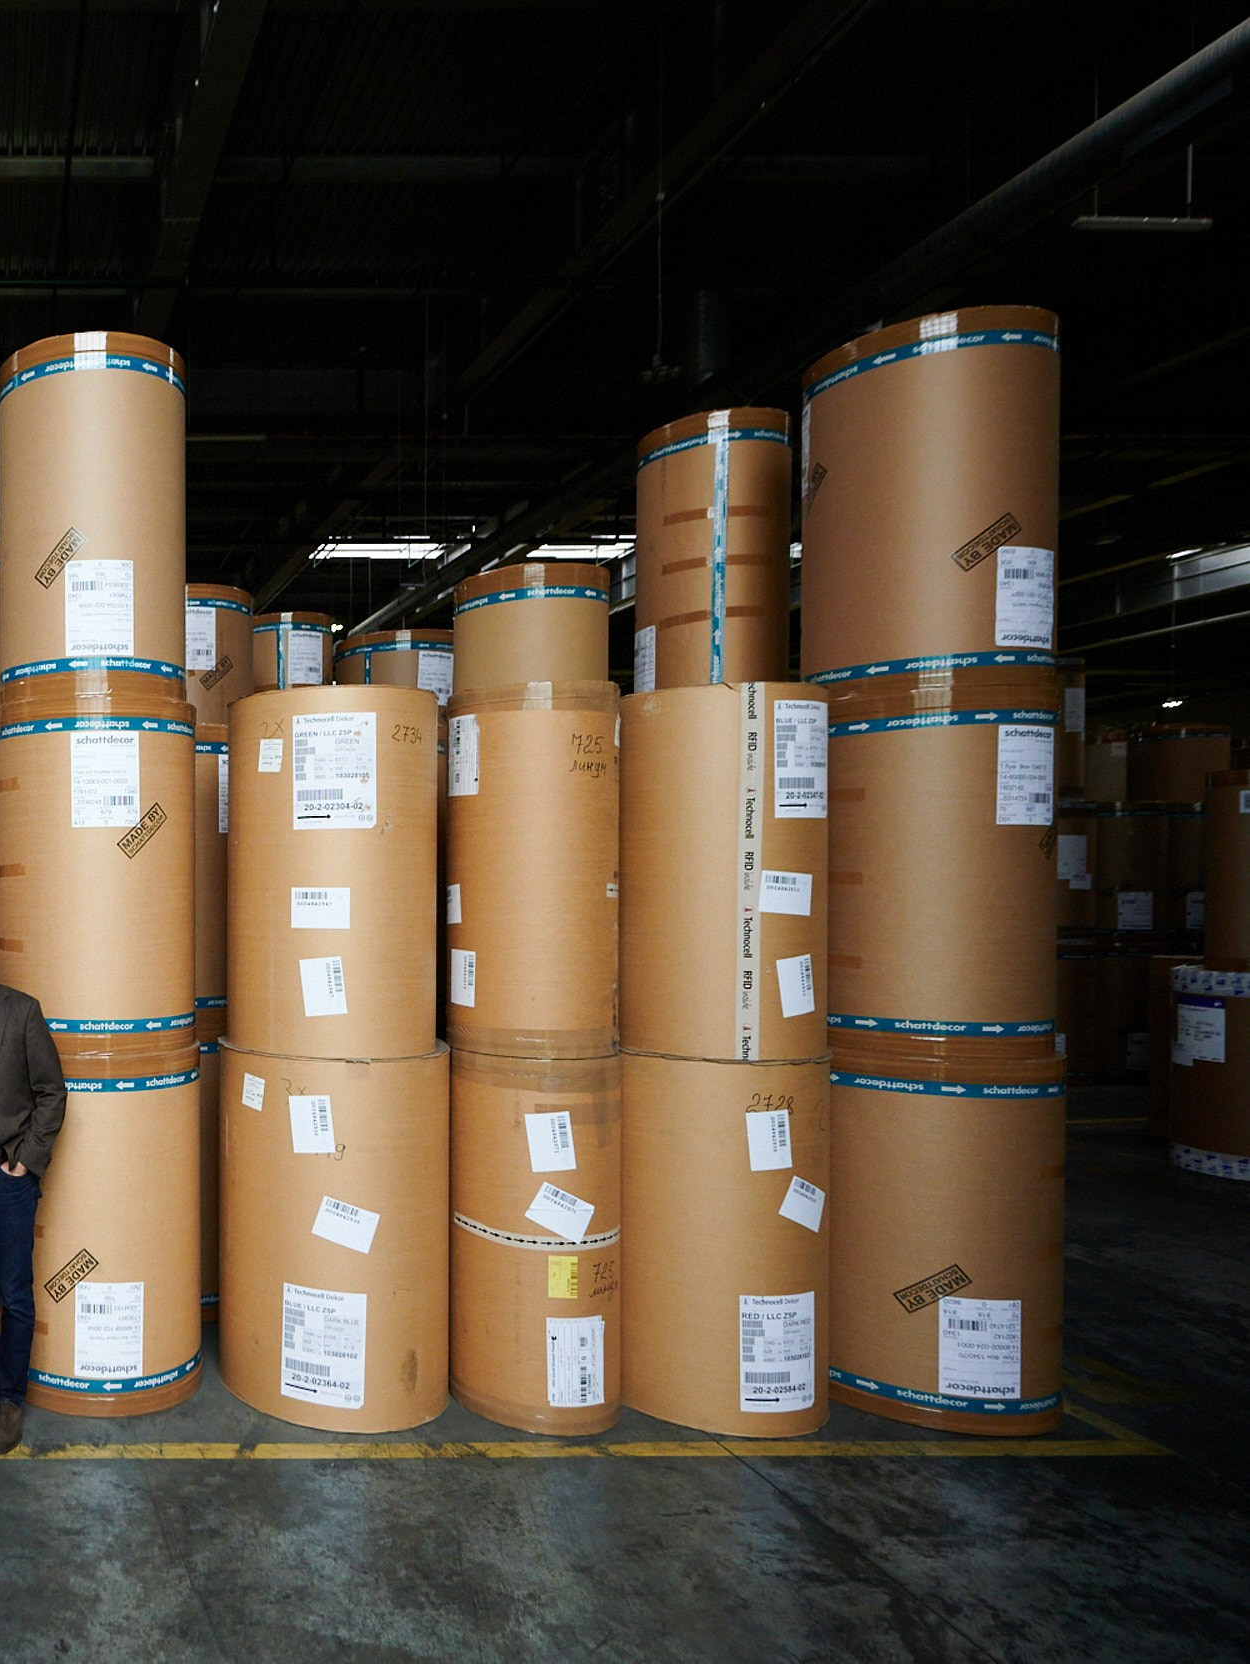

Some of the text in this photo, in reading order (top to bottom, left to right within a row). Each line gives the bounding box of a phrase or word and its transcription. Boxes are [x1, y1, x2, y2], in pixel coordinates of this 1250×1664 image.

[964, 523, 1018, 567] MADE BY
[42, 533, 83, 585] MADE BY
[527, 588, 576, 597] schattdecor
[72, 643, 129, 652] schattdecor
[15, 662, 57, 676] schattdecor
[100, 659, 152, 669] schattdecor
[905, 656, 978, 670] schattdecor
[748, 682, 758, 720] echnocell
[886, 715, 959, 727] schattdecor
[1012, 711, 1054, 720] schattdecor
[1, 724, 35, 736] schattdecor
[75, 720, 130, 730] schattdecor
[76, 735, 134, 745] schattdecor
[1005, 728, 1052, 739] schattdecor
[748, 732, 758, 751] RFID
[745, 797, 756, 839] Technocell
[122, 807, 161, 850] MADE BY
[128, 814, 164, 855] SCHATTDECOR
[744, 851, 755, 871] RFID
[743, 917, 753, 959] Technocell
[742, 970, 753, 990] RFID
[79, 1022, 134, 1031] schattdecor
[895, 1021, 967, 1032] schattdecor
[65, 1081, 103, 1091] schattd
[146, 1075, 185, 1087] schattdecor
[854, 1077, 924, 1091] schattdecor
[983, 1086, 1039, 1095] schattdecor
[48, 1252, 88, 1292] SCHATTDECOR
[53, 1257, 95, 1299] MADE BY
[899, 1269, 960, 1300] SCHATTDECOR
[908, 1275, 967, 1308] MADE BY
[284, 1299, 301, 1308] BLUE
[742, 1312, 760, 1320] RED
[767, 1312, 782, 1320] LLC
[80, 1364, 138, 1375] schattdecor
[39, 1374, 90, 1389] schattdecor
[134, 1371, 179, 1388] schattdecor
[945, 1383, 1015, 1395] schattdecor
[897, 1388, 968, 1407] schattdecor
